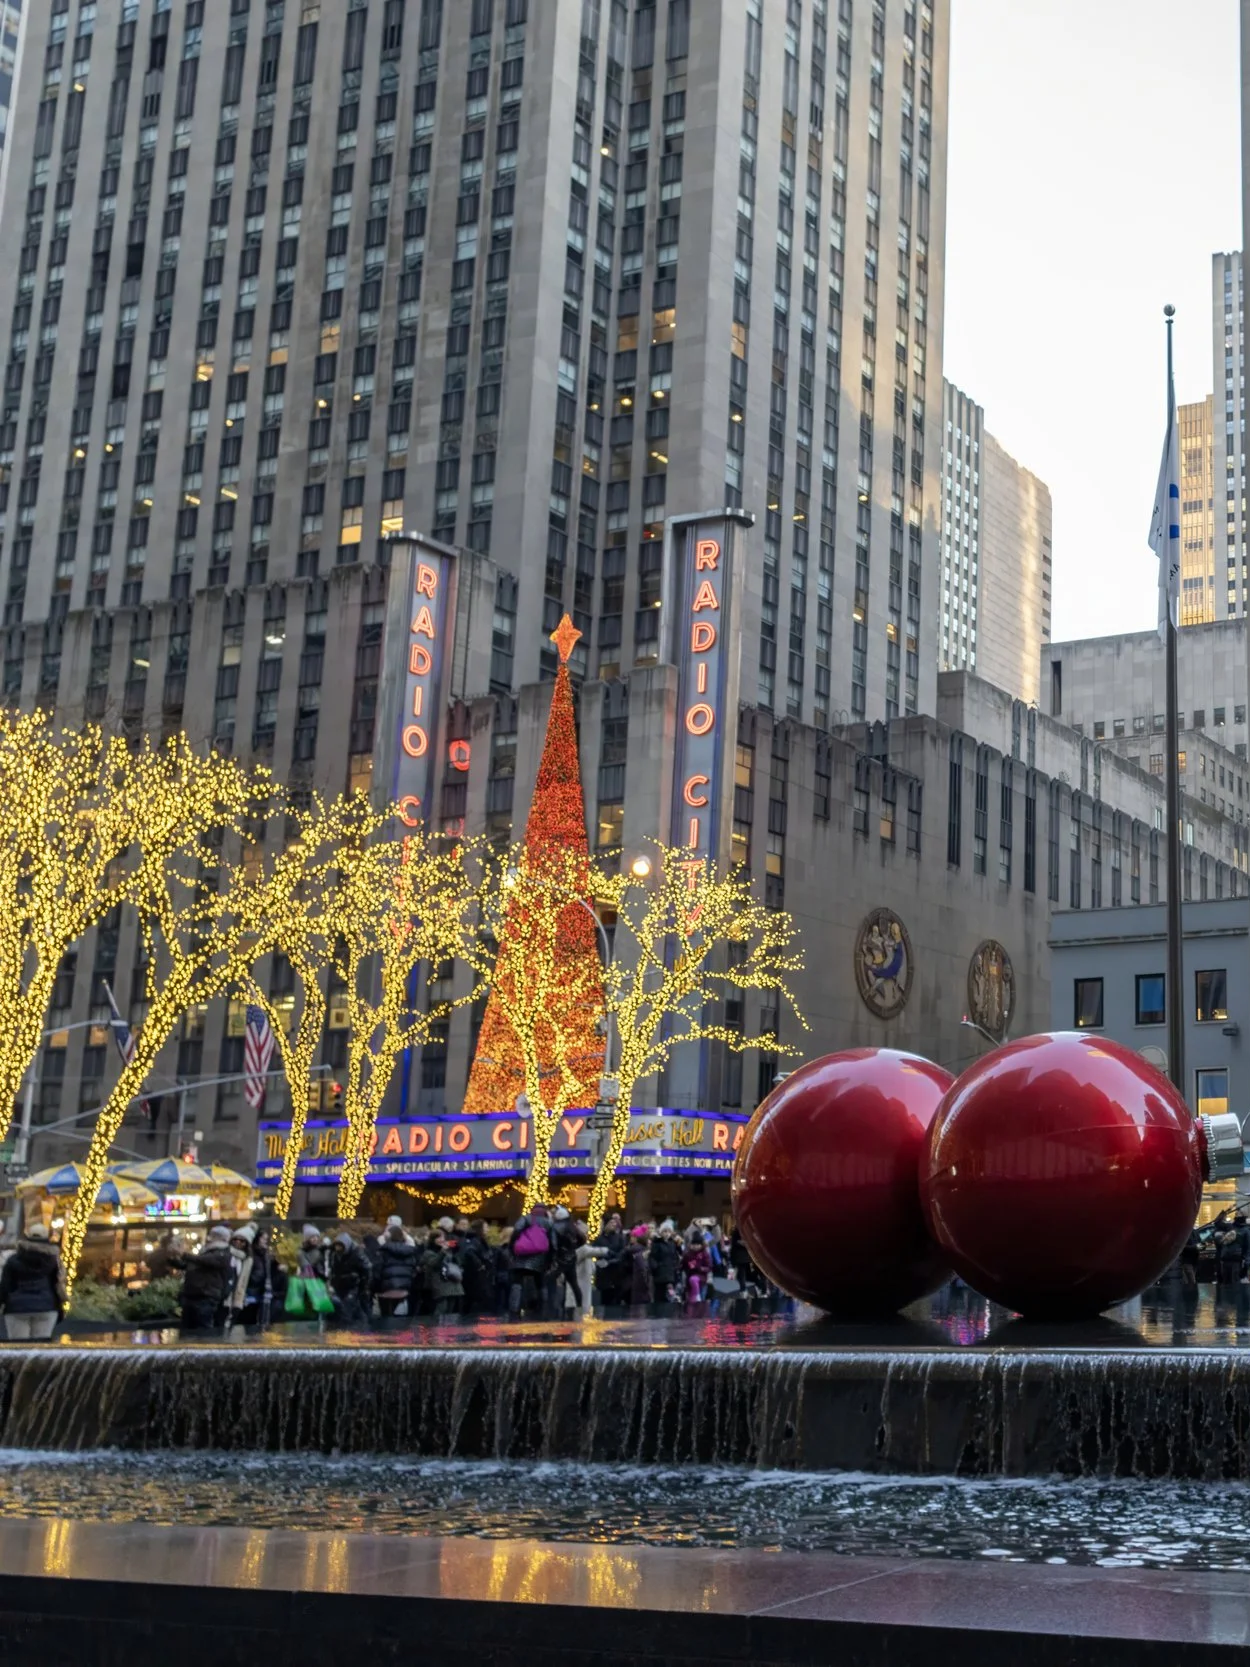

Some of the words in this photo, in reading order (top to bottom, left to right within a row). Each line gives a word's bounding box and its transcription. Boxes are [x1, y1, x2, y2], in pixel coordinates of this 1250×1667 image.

[686, 539, 719, 735] RADIO
[402, 563, 437, 757] RADIO
[492, 1118, 585, 1150] CIY
[612, 1121, 665, 1144] usic
[661, 1118, 705, 1149] Hall
[324, 1163, 379, 1175] CHRAS
[385, 1161, 458, 1173] SPECTACULAR
[463, 1159, 513, 1170] STARRING
[693, 1158, 712, 1169] NOW
